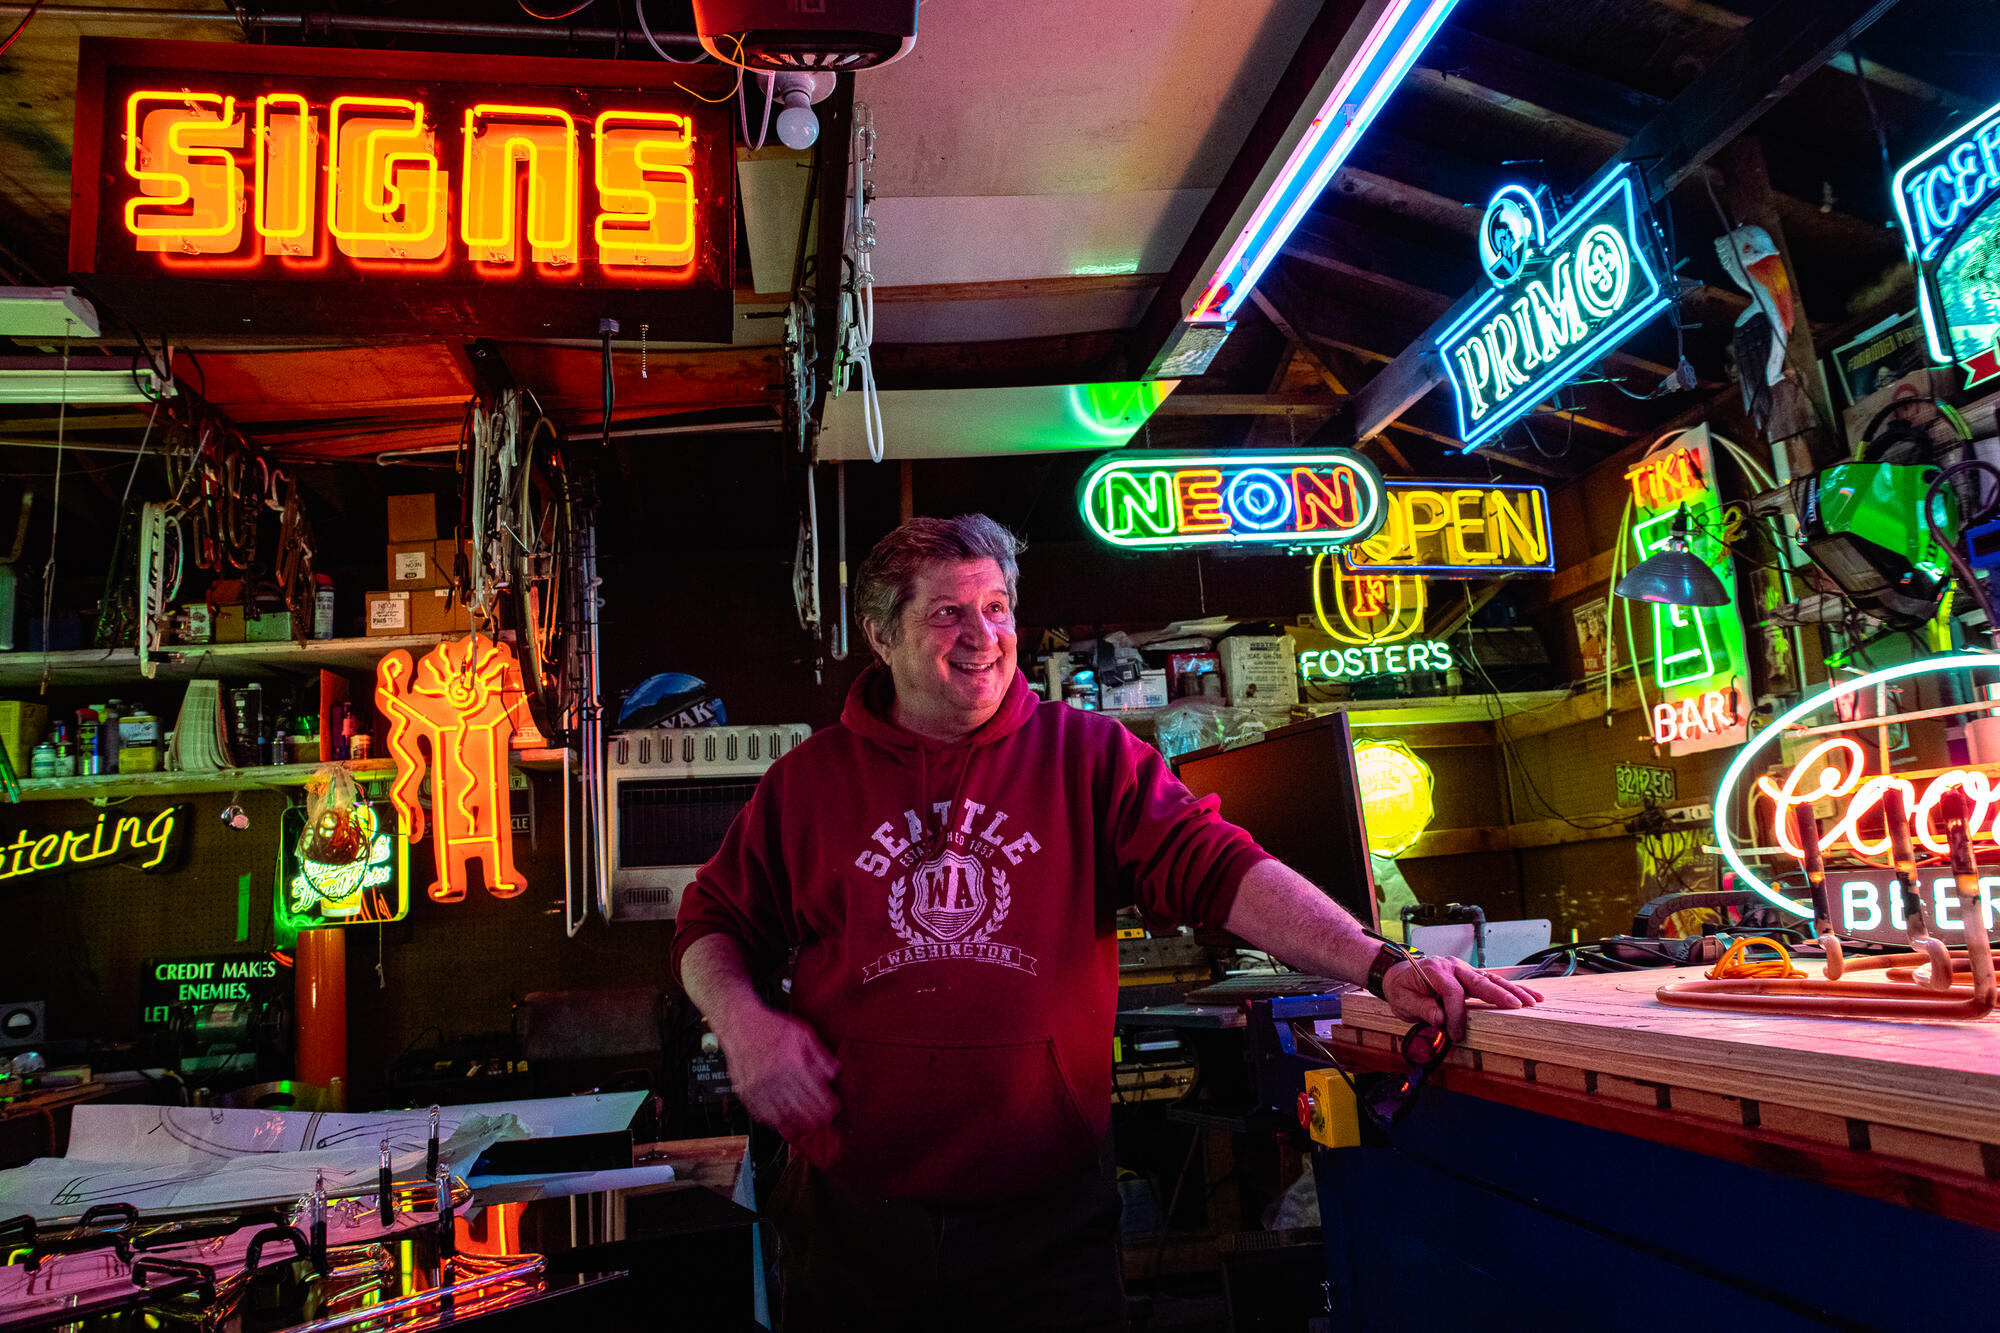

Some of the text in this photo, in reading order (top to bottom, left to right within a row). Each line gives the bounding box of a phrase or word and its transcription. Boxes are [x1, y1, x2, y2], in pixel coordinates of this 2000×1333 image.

[125, 90, 697, 266] SIGNS
[1456, 223, 1631, 422] PRIMO
[1105, 466, 1358, 536] NEON
[1300, 640, 1453, 679] FOSTER'S
[1653, 690, 1736, 745] BAR
[0, 806, 175, 880] tering
[511, 817, 529, 830] CLE
[855, 798, 1042, 878] SEATTLE
[969, 839, 996, 859] 1853
[925, 864, 977, 911] WA
[155, 960, 276, 981] CREDIT MAKES
[886, 942, 1013, 965] WASHINGTON
[179, 982, 251, 1002] ENEMIES,
[711, 1072, 729, 1080] WEL
